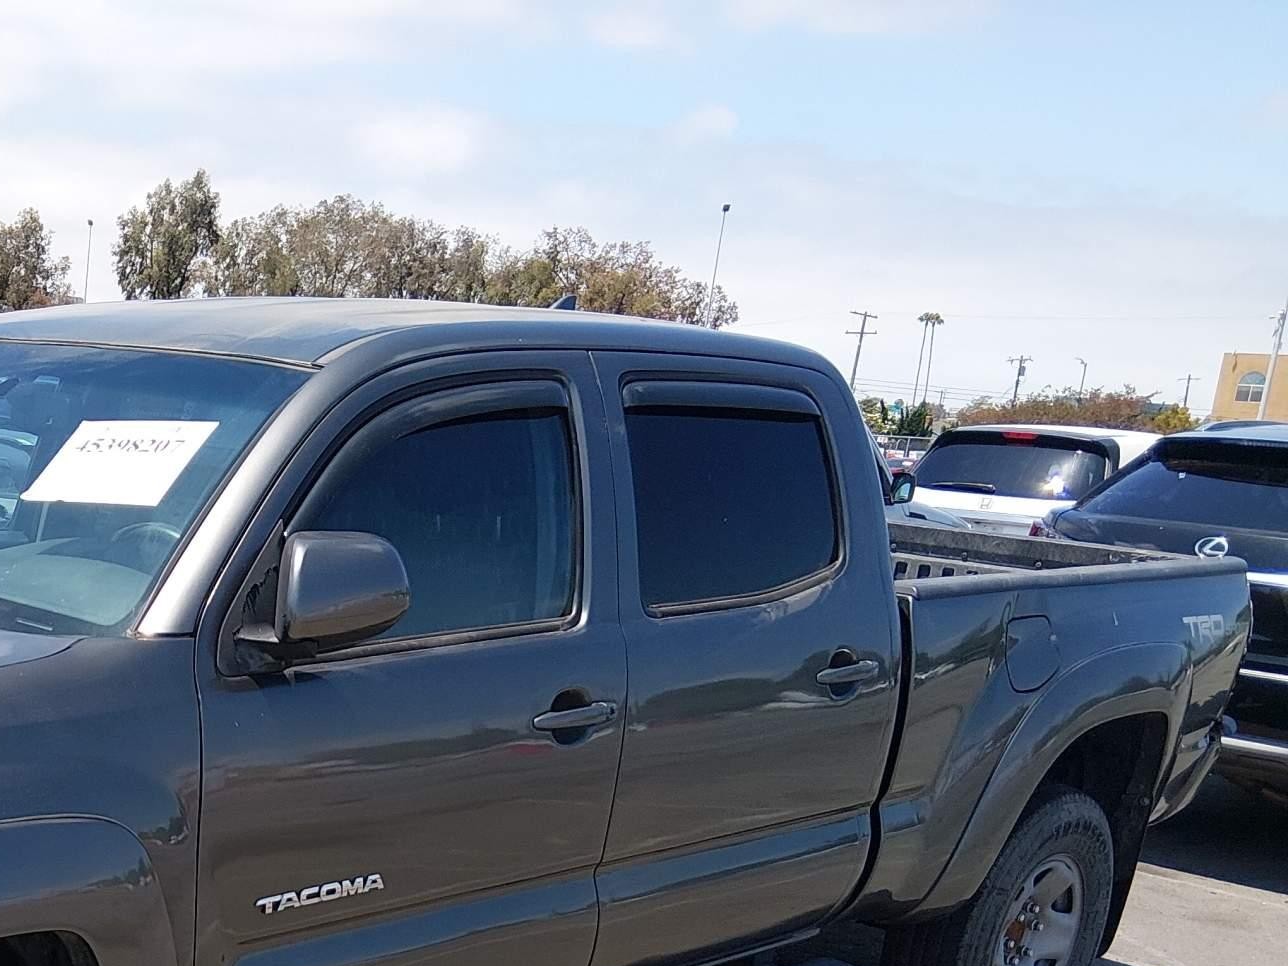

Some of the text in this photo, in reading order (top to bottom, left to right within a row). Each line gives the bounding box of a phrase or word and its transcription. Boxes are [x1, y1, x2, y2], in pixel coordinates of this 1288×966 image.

[75, 437, 187, 453] 45398207
[1181, 614, 1225, 645] TRD
[254, 872, 385, 915] TACOMA
